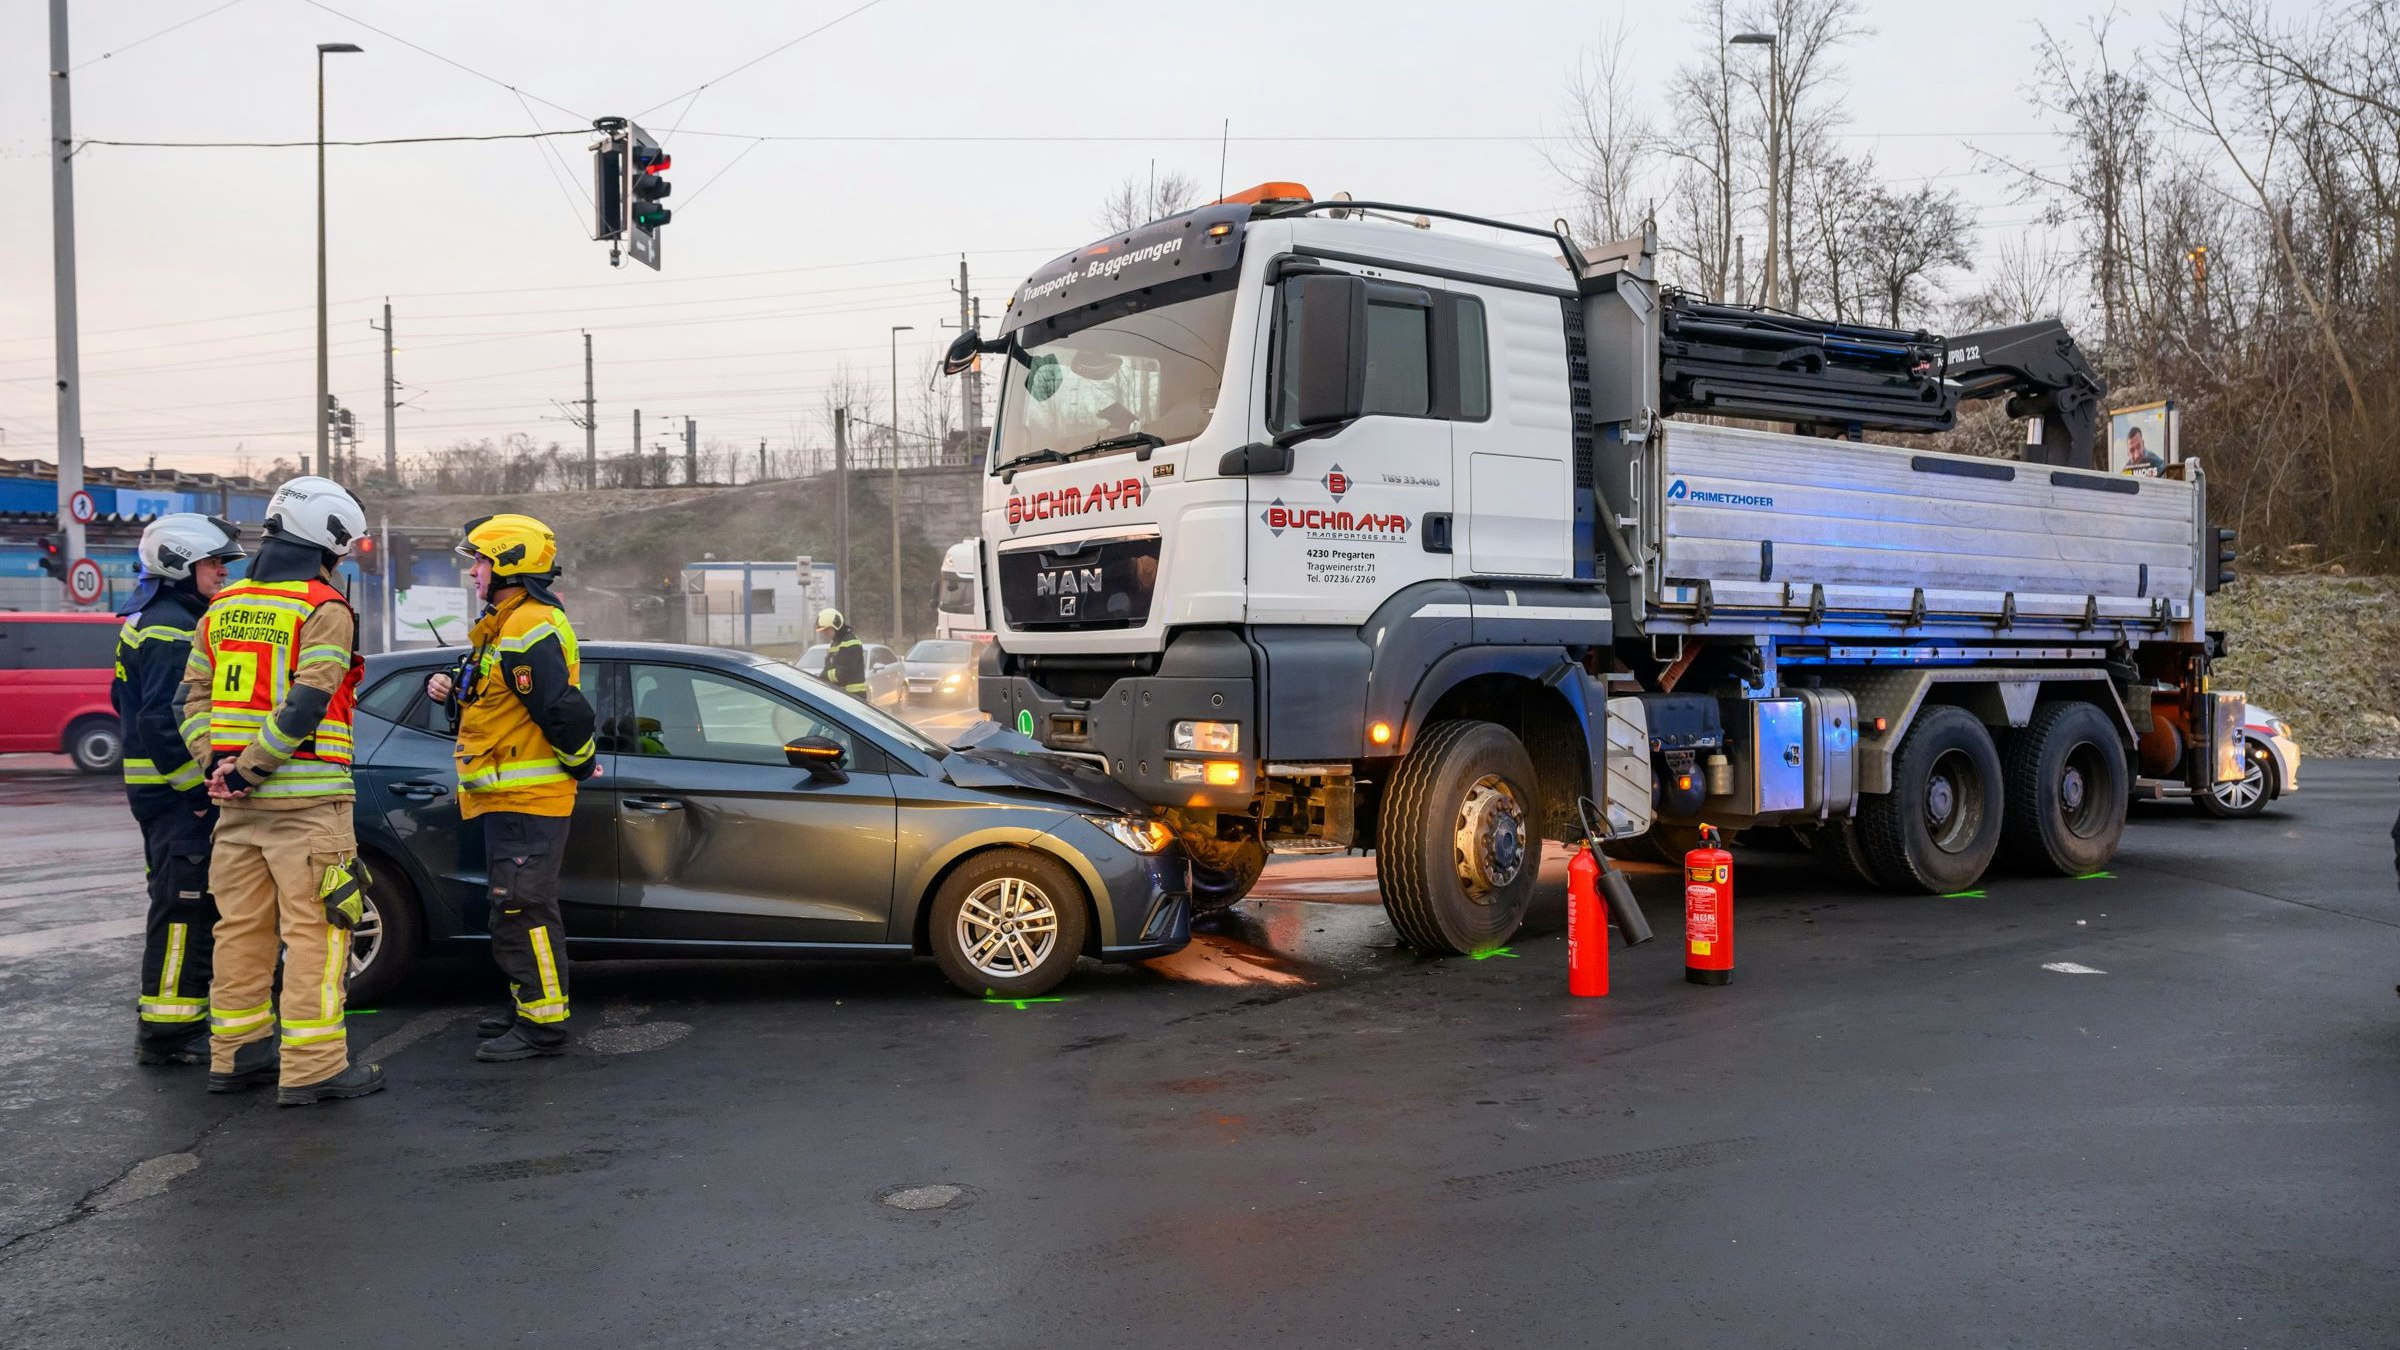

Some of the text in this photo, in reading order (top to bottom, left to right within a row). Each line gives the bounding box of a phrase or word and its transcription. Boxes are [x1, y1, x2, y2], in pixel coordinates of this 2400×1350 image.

[1023, 271, 1079, 302] Transporte
[1086, 237, 1183, 278] Baggerungen
[1965, 345, 1980, 361] 232
[1154, 464, 1173, 476] EEV
[1329, 473, 1346, 494] B
[1008, 478, 1142, 525] BUCHMAYR
[1690, 491, 1774, 507] PRIMETZHOFER
[1269, 508, 1406, 534] BUCHMAYR
[175, 546, 193, 558] 028
[491, 543, 507, 554] 010
[1306, 549, 1375, 561] 4230 Pregarten
[77, 571, 95, 591] 60
[1036, 568, 1103, 597] MAN
[1307, 574, 1376, 584] Tel. 07236/2769
[225, 664, 242, 692] H
